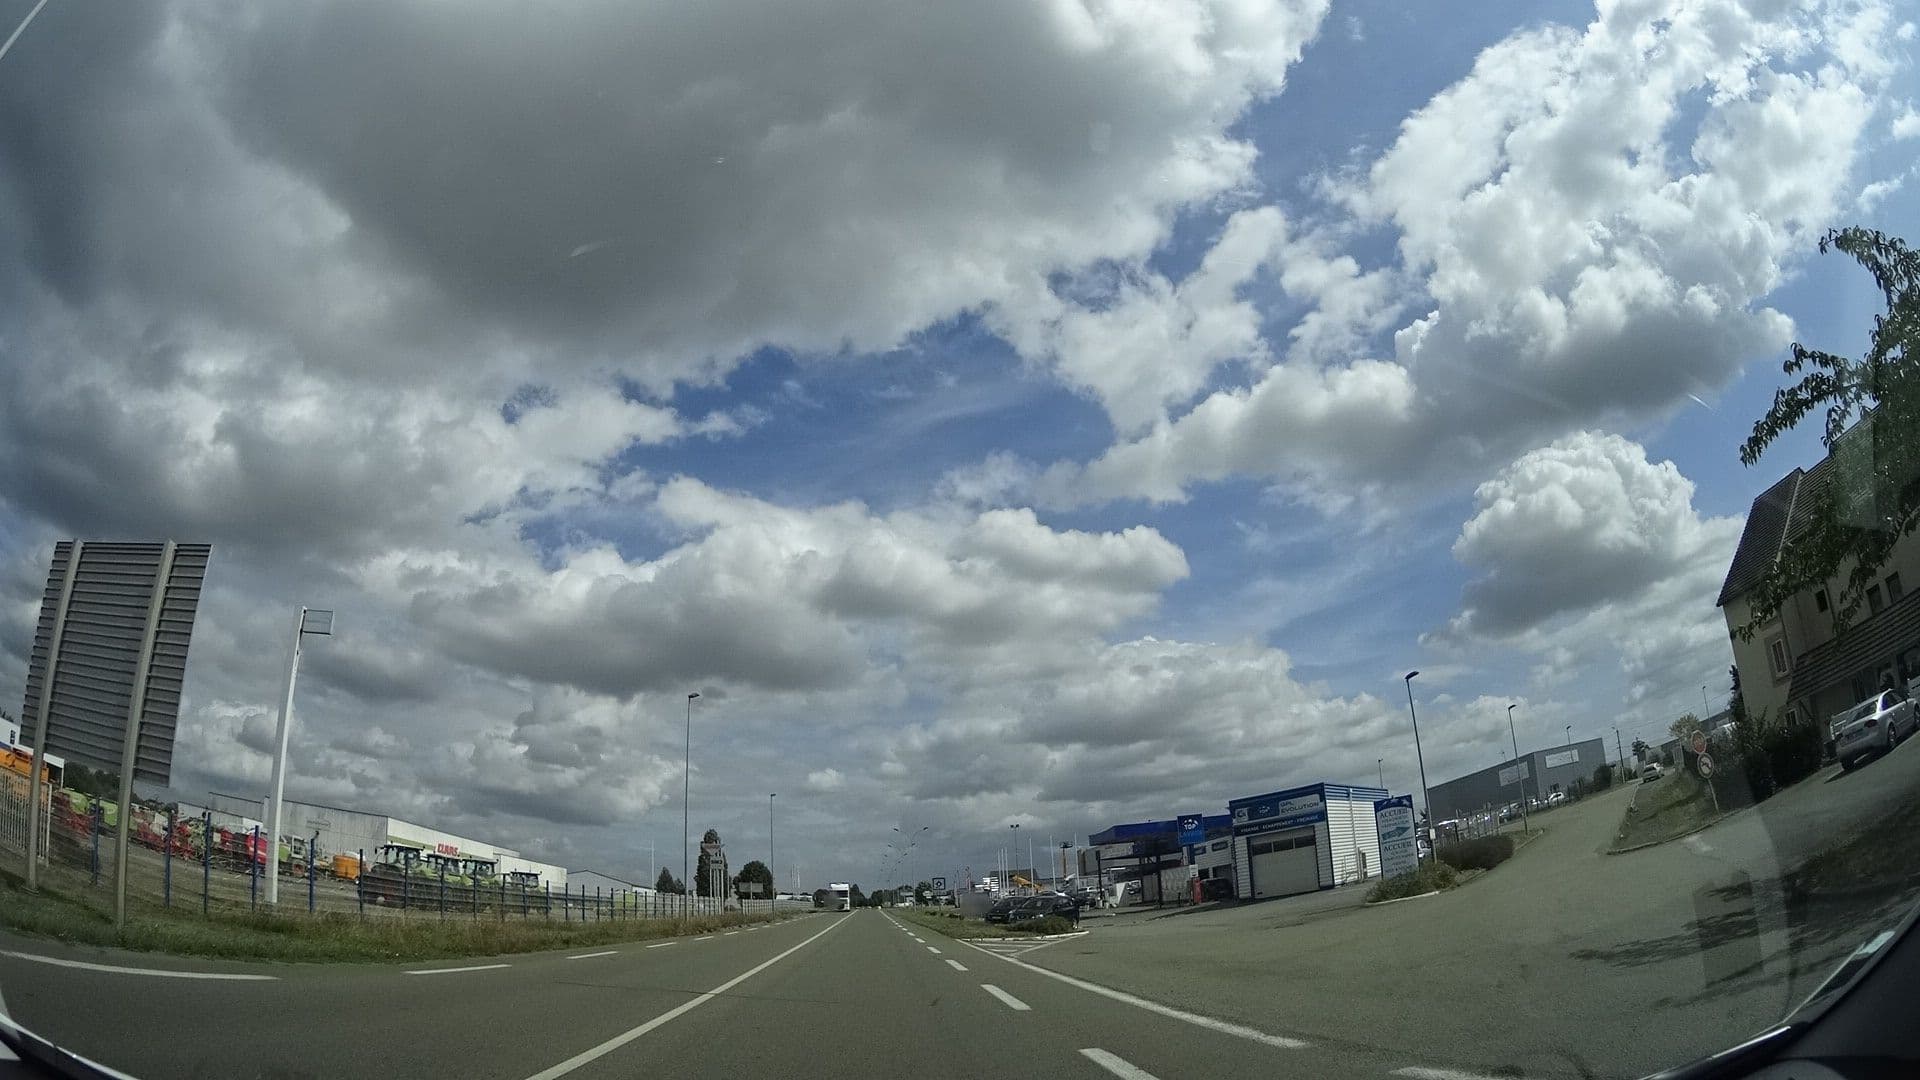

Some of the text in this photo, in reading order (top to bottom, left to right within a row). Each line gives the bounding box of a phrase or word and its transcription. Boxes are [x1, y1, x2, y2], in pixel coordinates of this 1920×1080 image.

[1281, 802, 1319, 814] EVOLUTION
[1380, 808, 1408, 818] ACCUEIL
[1384, 840, 1413, 851] ACCUEIL
